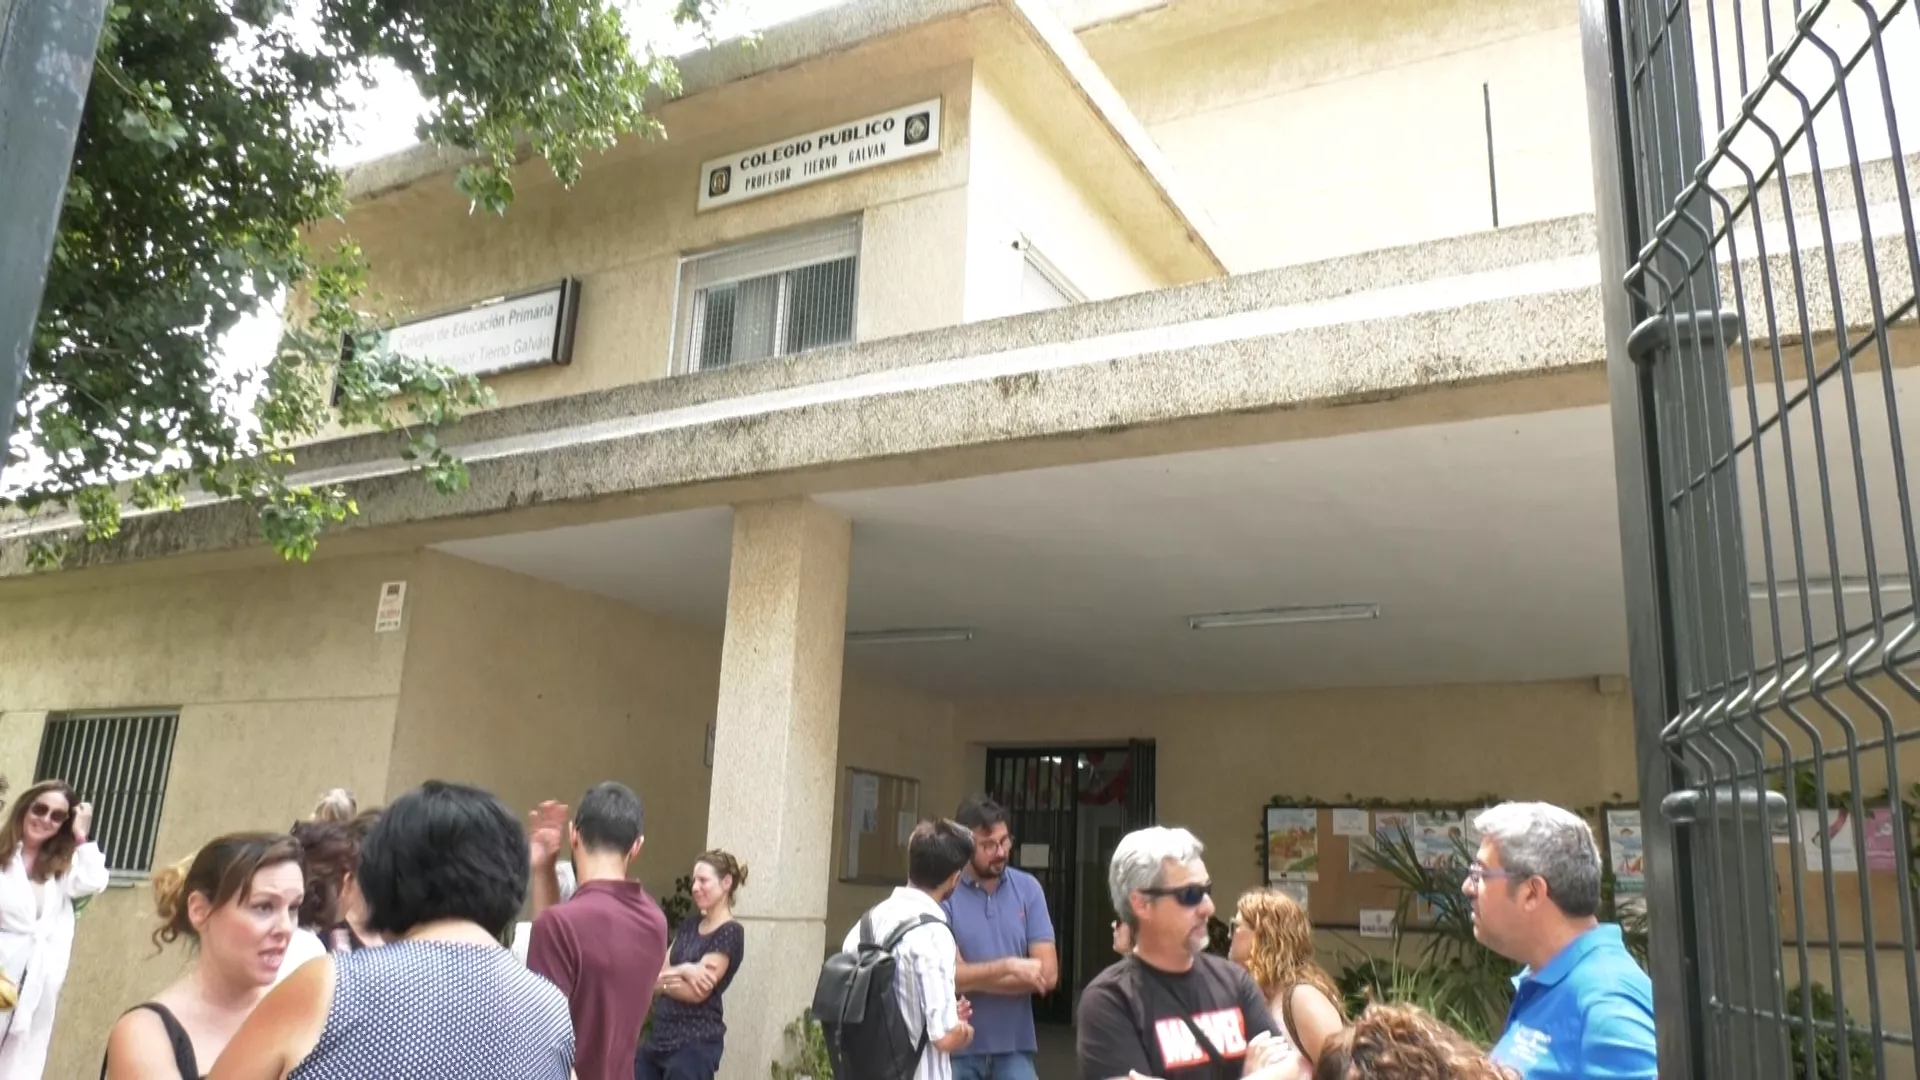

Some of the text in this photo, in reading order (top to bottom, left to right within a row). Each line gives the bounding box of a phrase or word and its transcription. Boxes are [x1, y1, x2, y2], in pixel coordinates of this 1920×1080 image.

[740, 117, 895, 171] COLEGIO PUBLICO
[745, 141, 887, 191] PROFESOR TIERNO GALVAN
[399, 301, 555, 350] Colegio de Educación Primaria
[479, 344, 511, 362] Tierno
[513, 331, 551, 354] Galván
[1155, 1008, 1247, 1066] MAVEL
